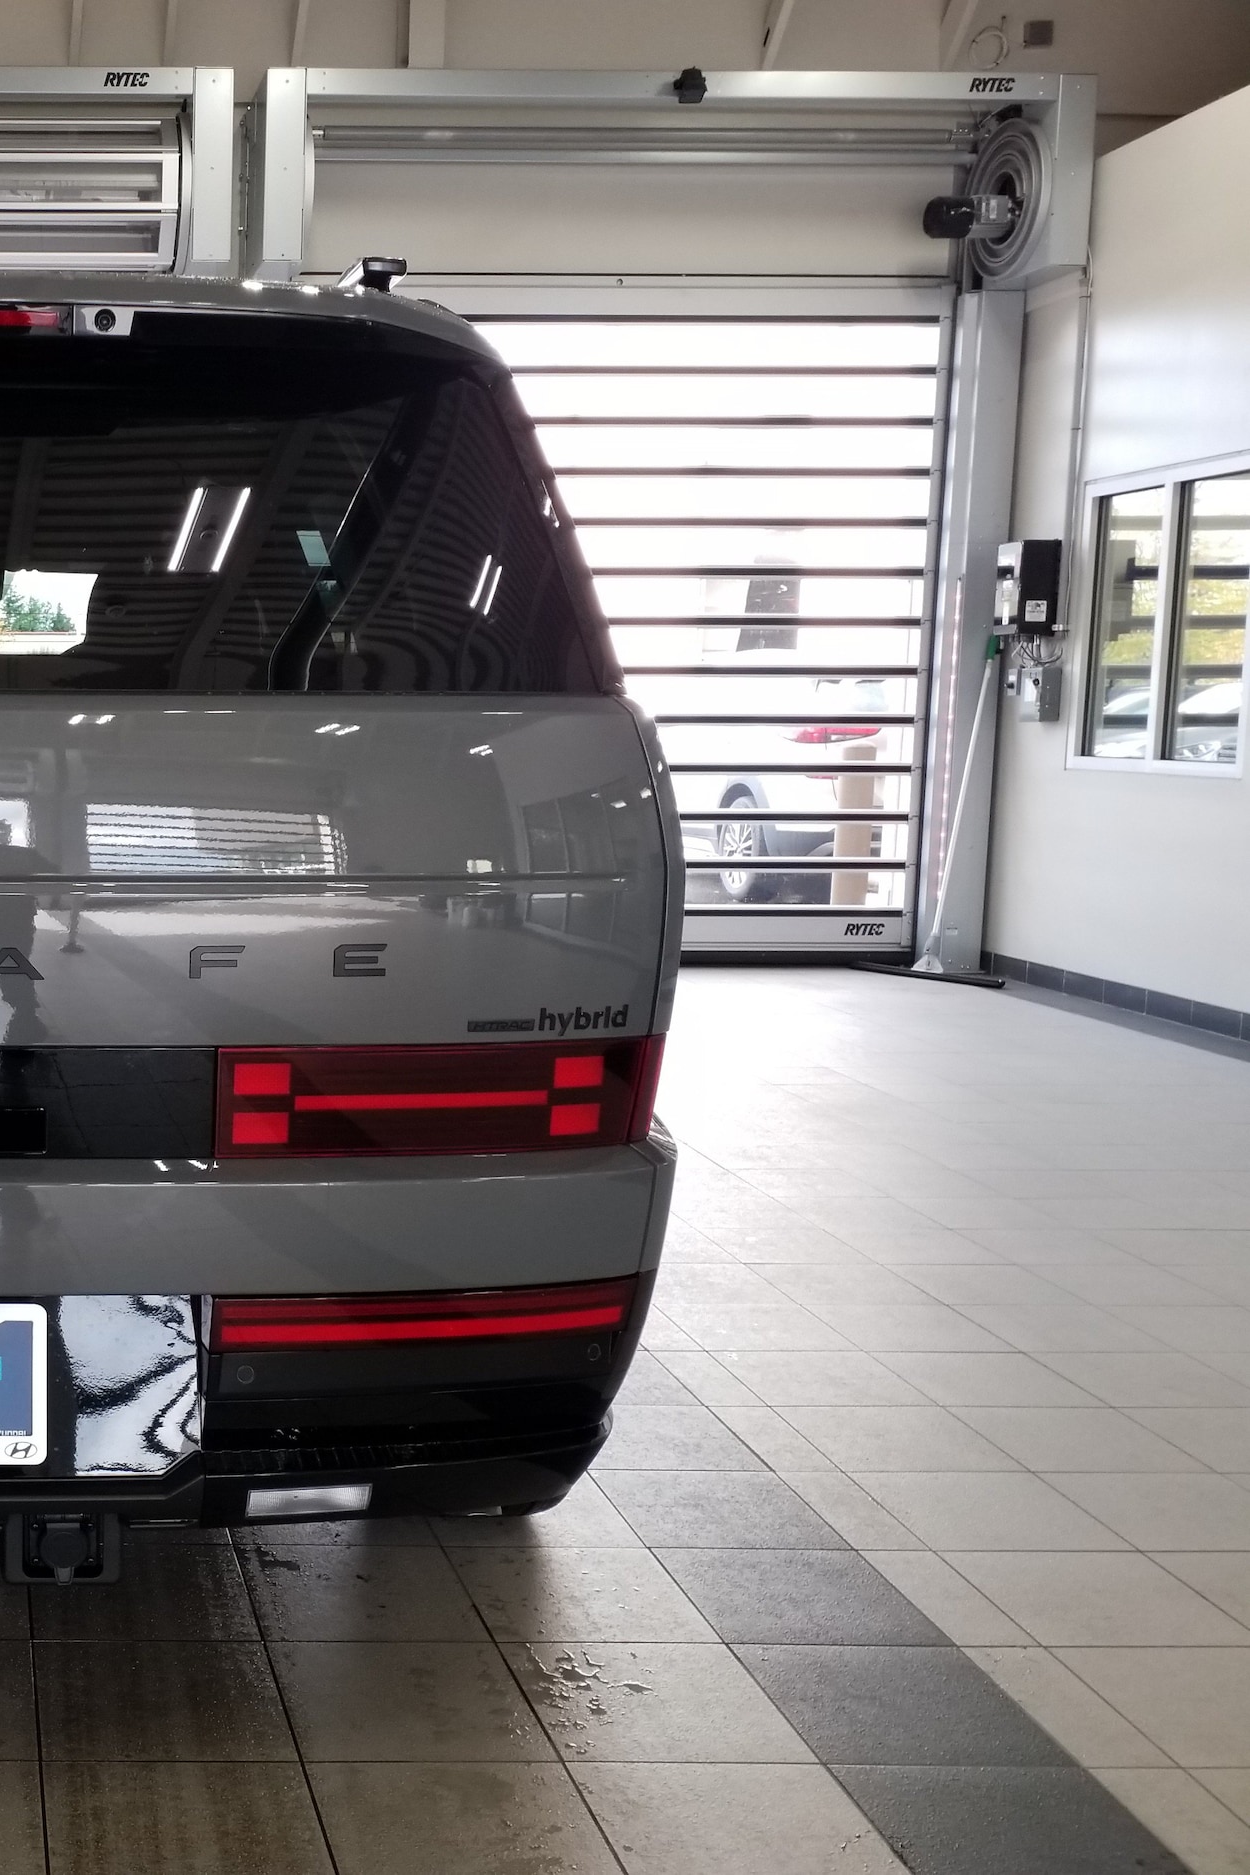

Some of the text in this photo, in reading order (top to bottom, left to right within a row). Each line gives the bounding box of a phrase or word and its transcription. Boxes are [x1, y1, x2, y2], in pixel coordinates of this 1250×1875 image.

[103, 72, 150, 87] RYTEC
[969, 77, 1016, 93] RYTEC
[844, 923, 885, 936] RYTEC
[189, 943, 388, 980] FE
[538, 1004, 629, 1036] hybrid
